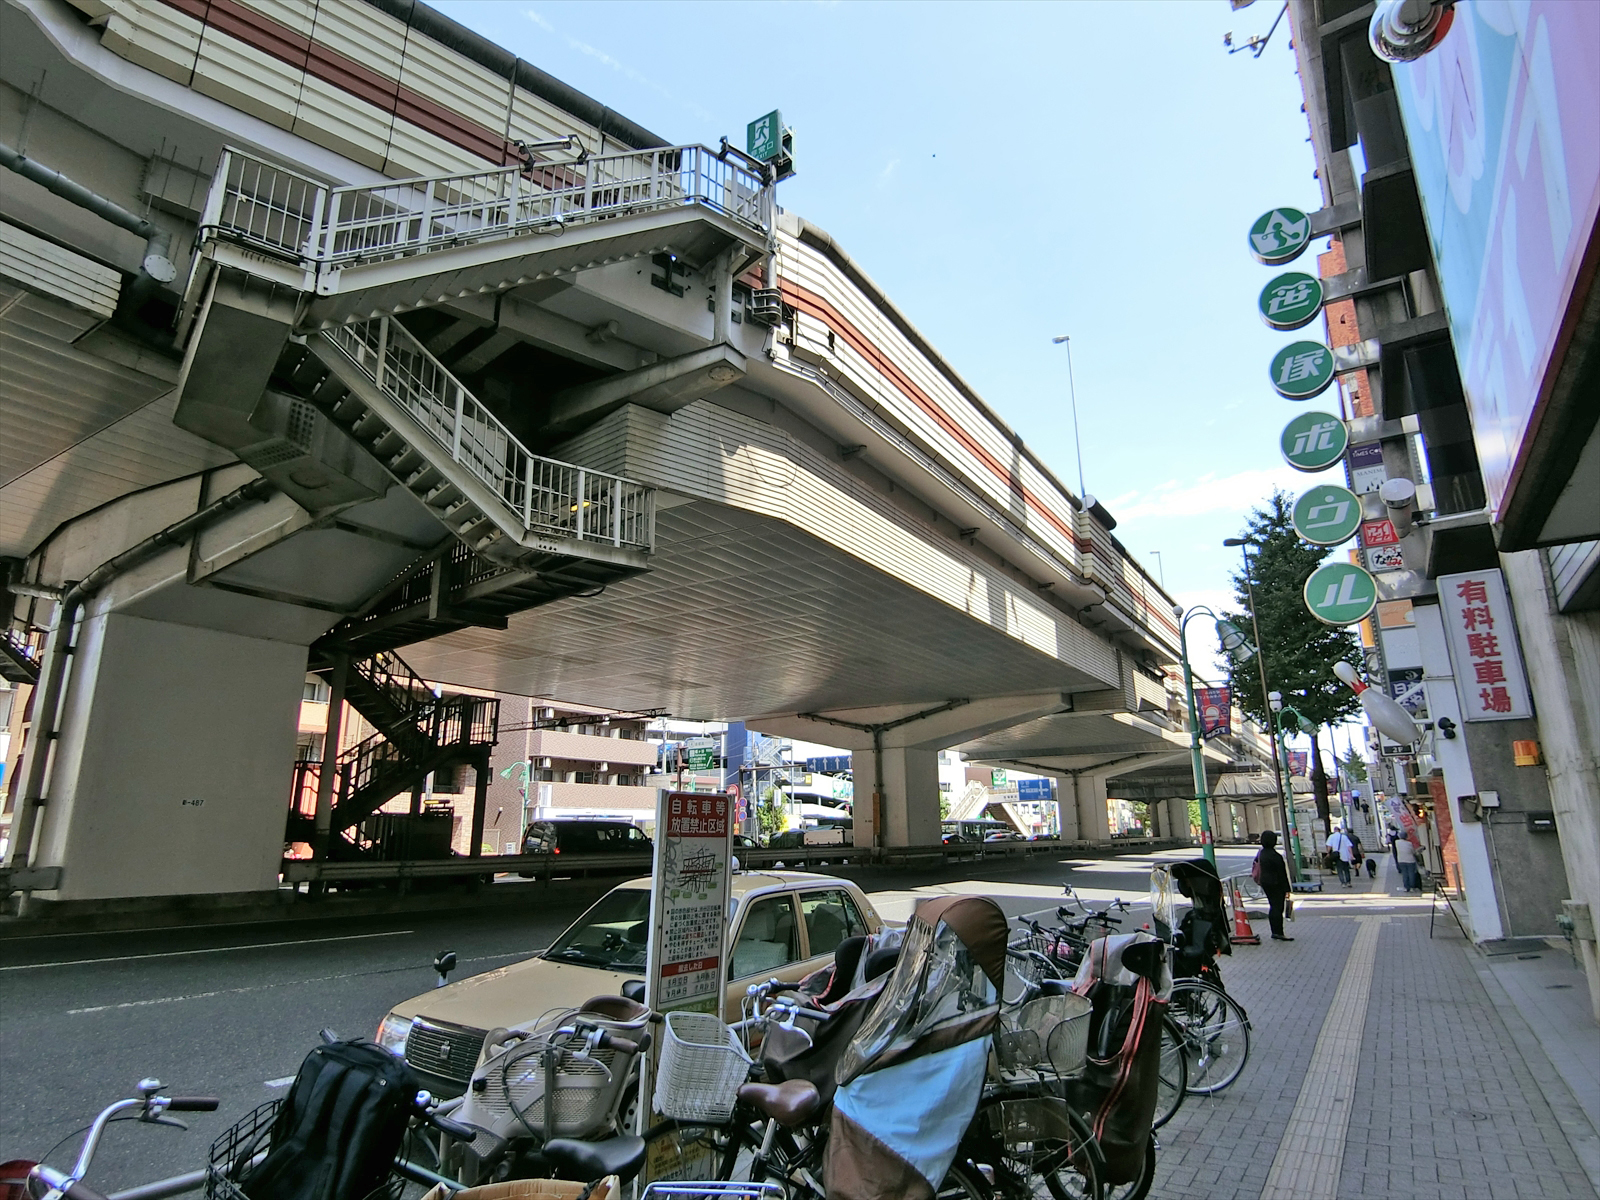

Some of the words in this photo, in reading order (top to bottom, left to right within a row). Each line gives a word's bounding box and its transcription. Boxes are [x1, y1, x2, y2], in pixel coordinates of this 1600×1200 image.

[1457, 579, 1513, 713] 有料駐車場
[672, 797, 726, 816] 自転車等
[671, 816, 725, 834] 放置禁止区域
